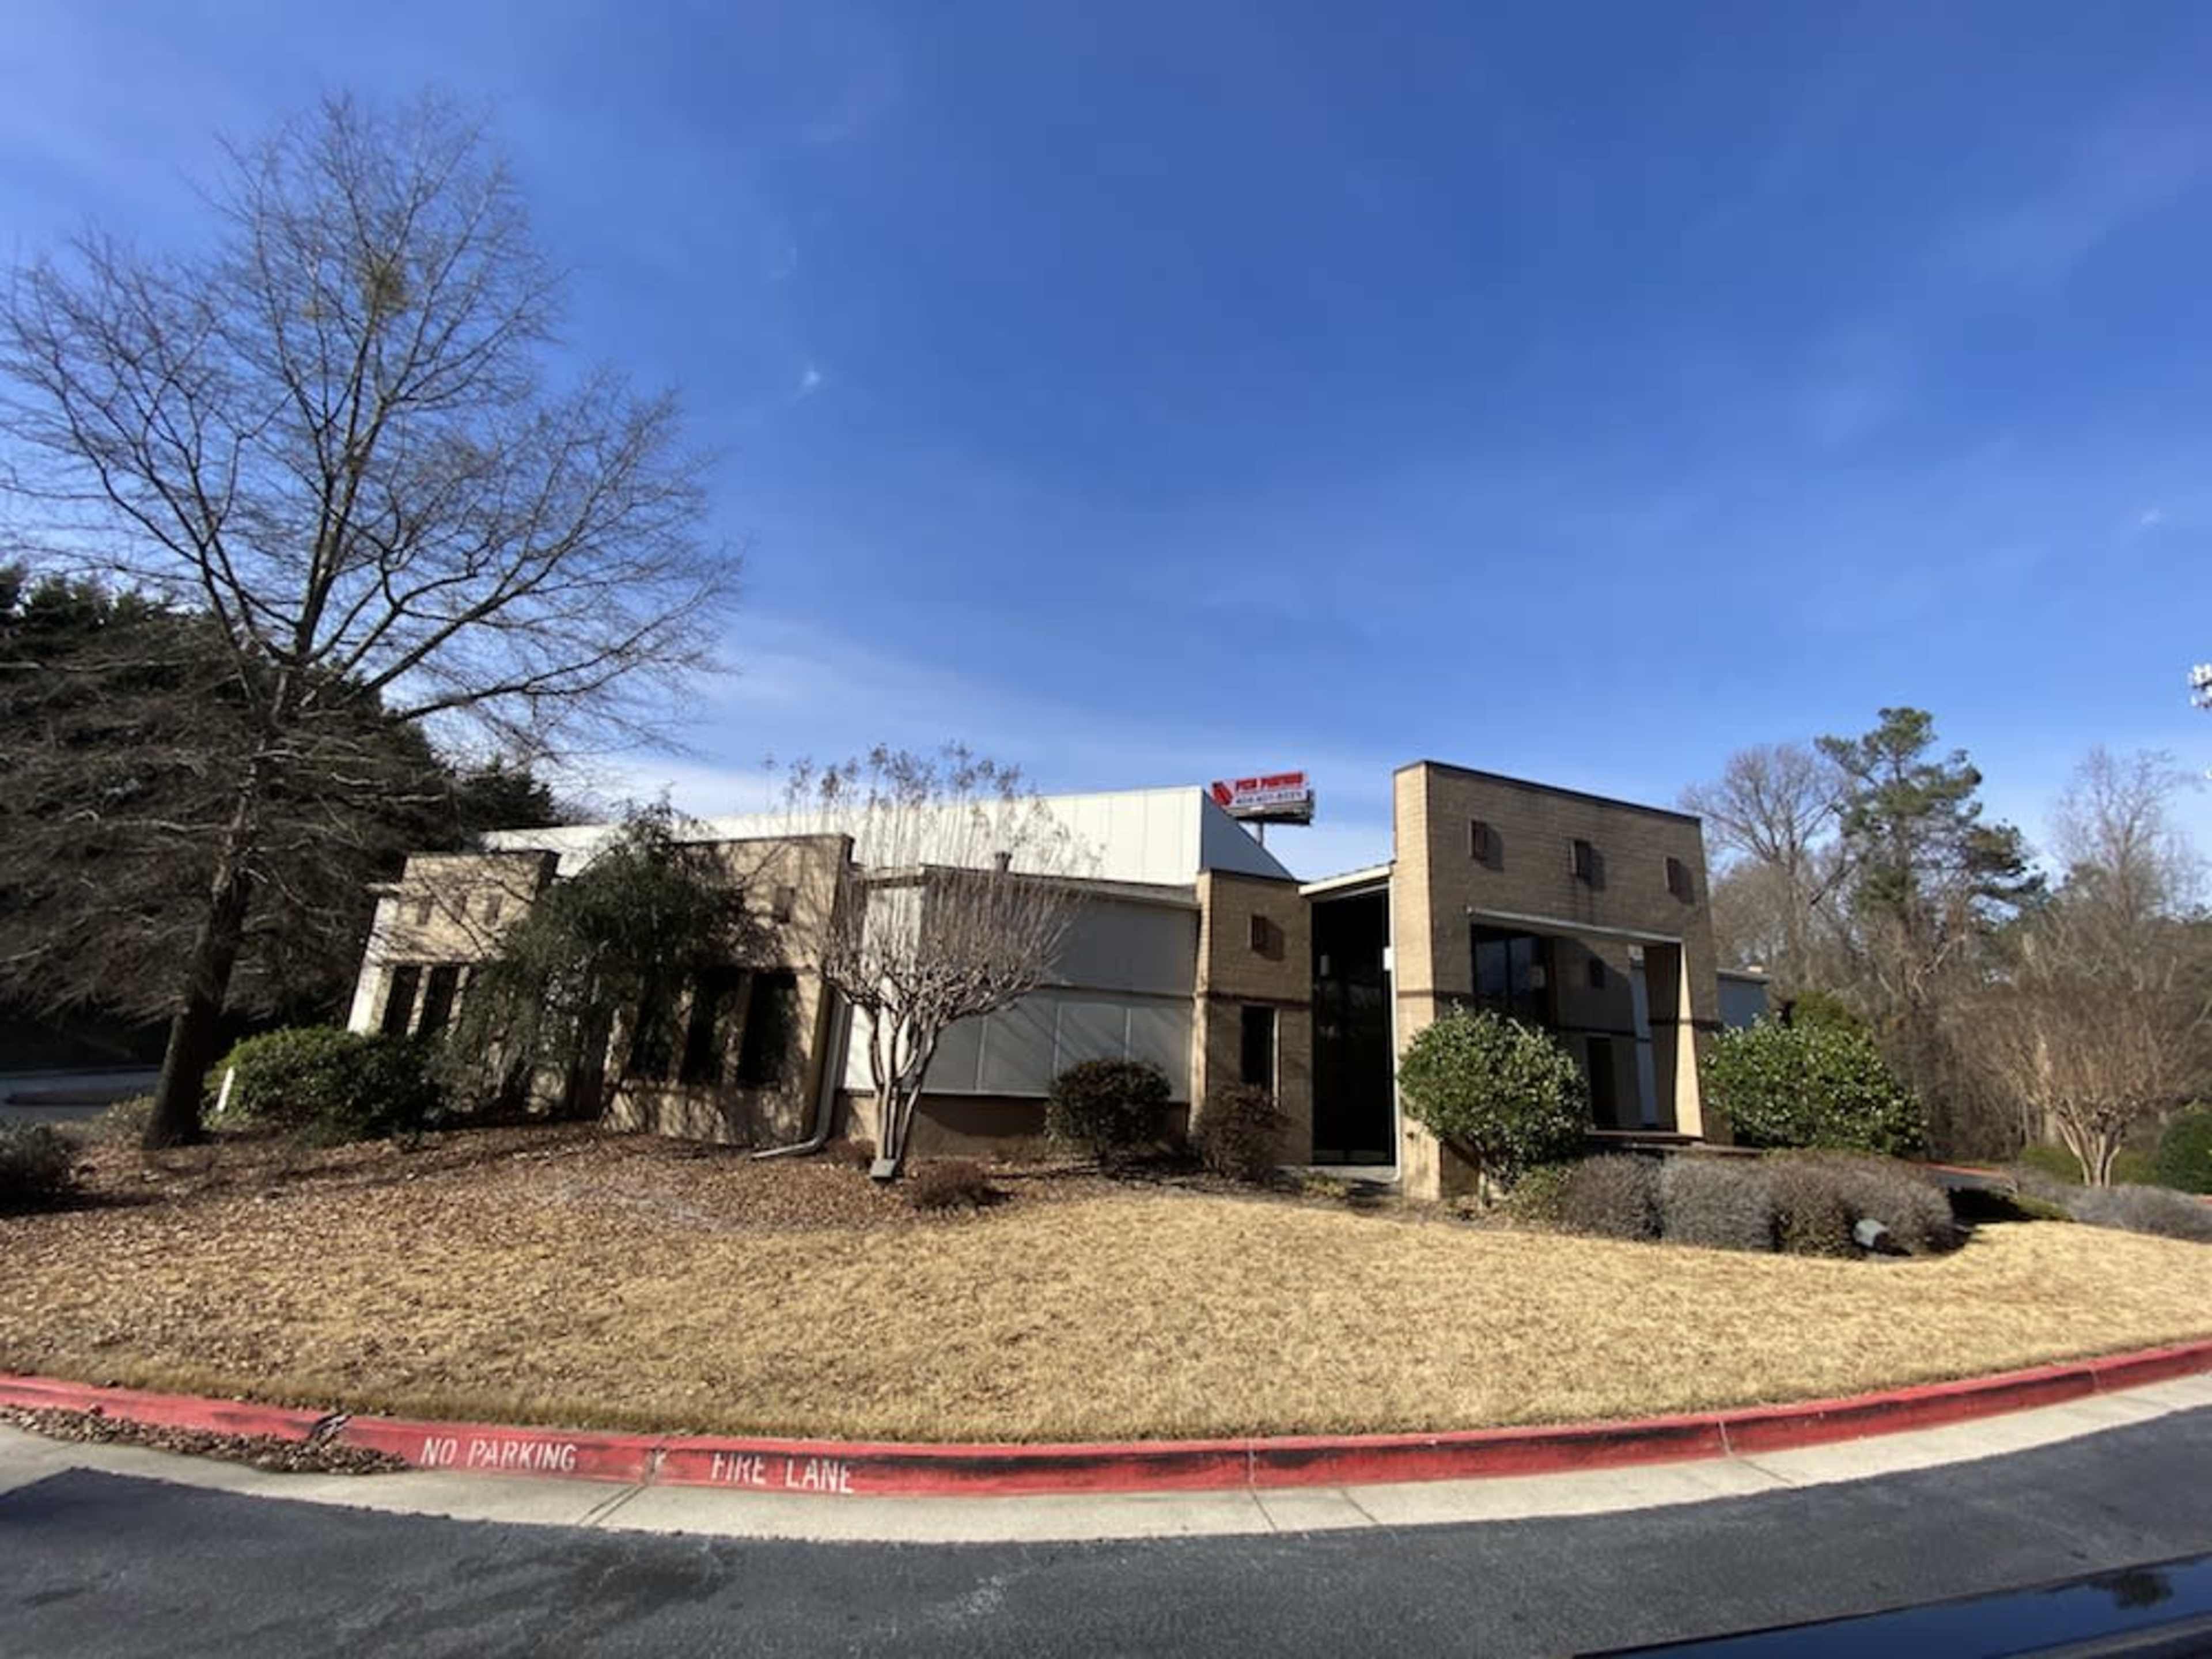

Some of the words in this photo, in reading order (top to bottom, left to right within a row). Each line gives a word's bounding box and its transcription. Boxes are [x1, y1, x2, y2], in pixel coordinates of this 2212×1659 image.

[420, 1437, 458, 1466] NO
[467, 1439, 577, 1471] PARKING
[711, 1452, 767, 1485] FIRE
[785, 1458, 855, 1494] LANE
